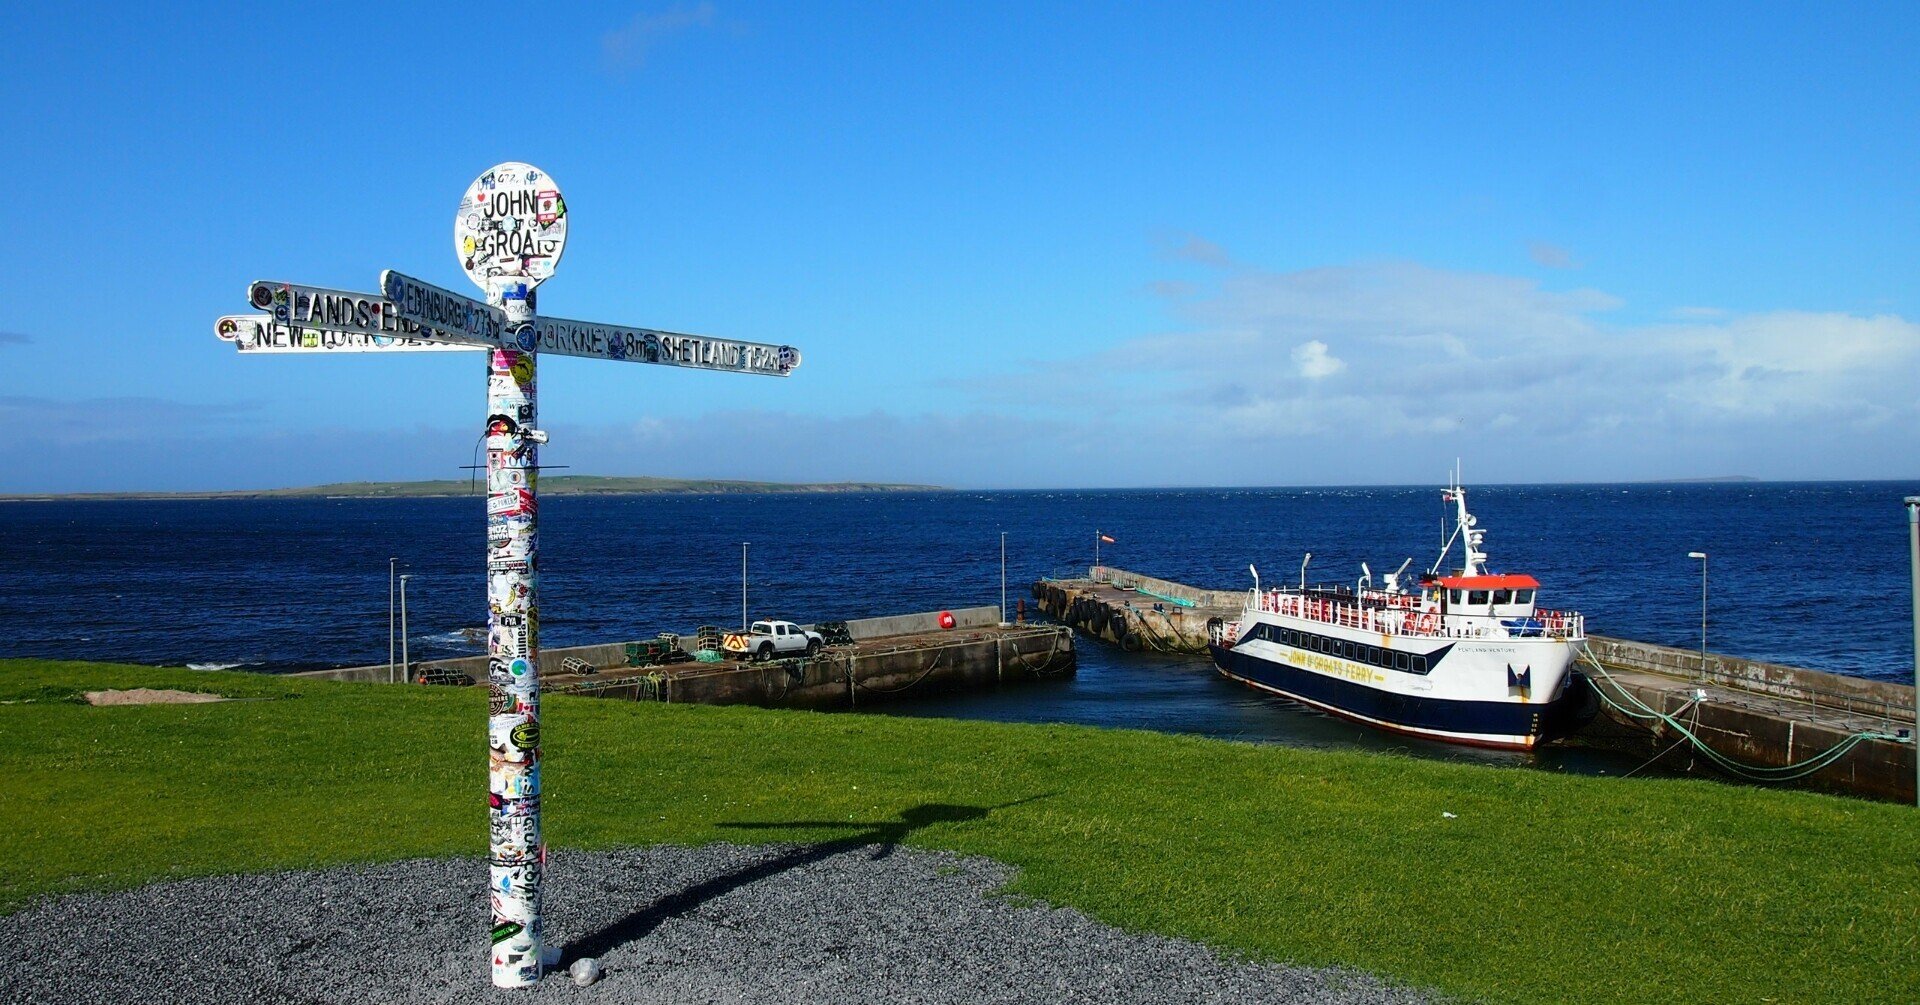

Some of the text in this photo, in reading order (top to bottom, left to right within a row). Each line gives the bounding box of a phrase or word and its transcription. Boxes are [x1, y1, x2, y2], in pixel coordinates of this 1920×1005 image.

[483, 189, 536, 218] JOHN
[292, 289, 370, 328] LANDS
[405, 283, 469, 331] EDINBURGH
[256, 321, 305, 348] NEW
[544, 324, 612, 355] ORKNEY
[661, 336, 739, 367] SHETLAND
[1288, 650, 1305, 667] JOHN
[1345, 663, 1374, 684] FERRY
